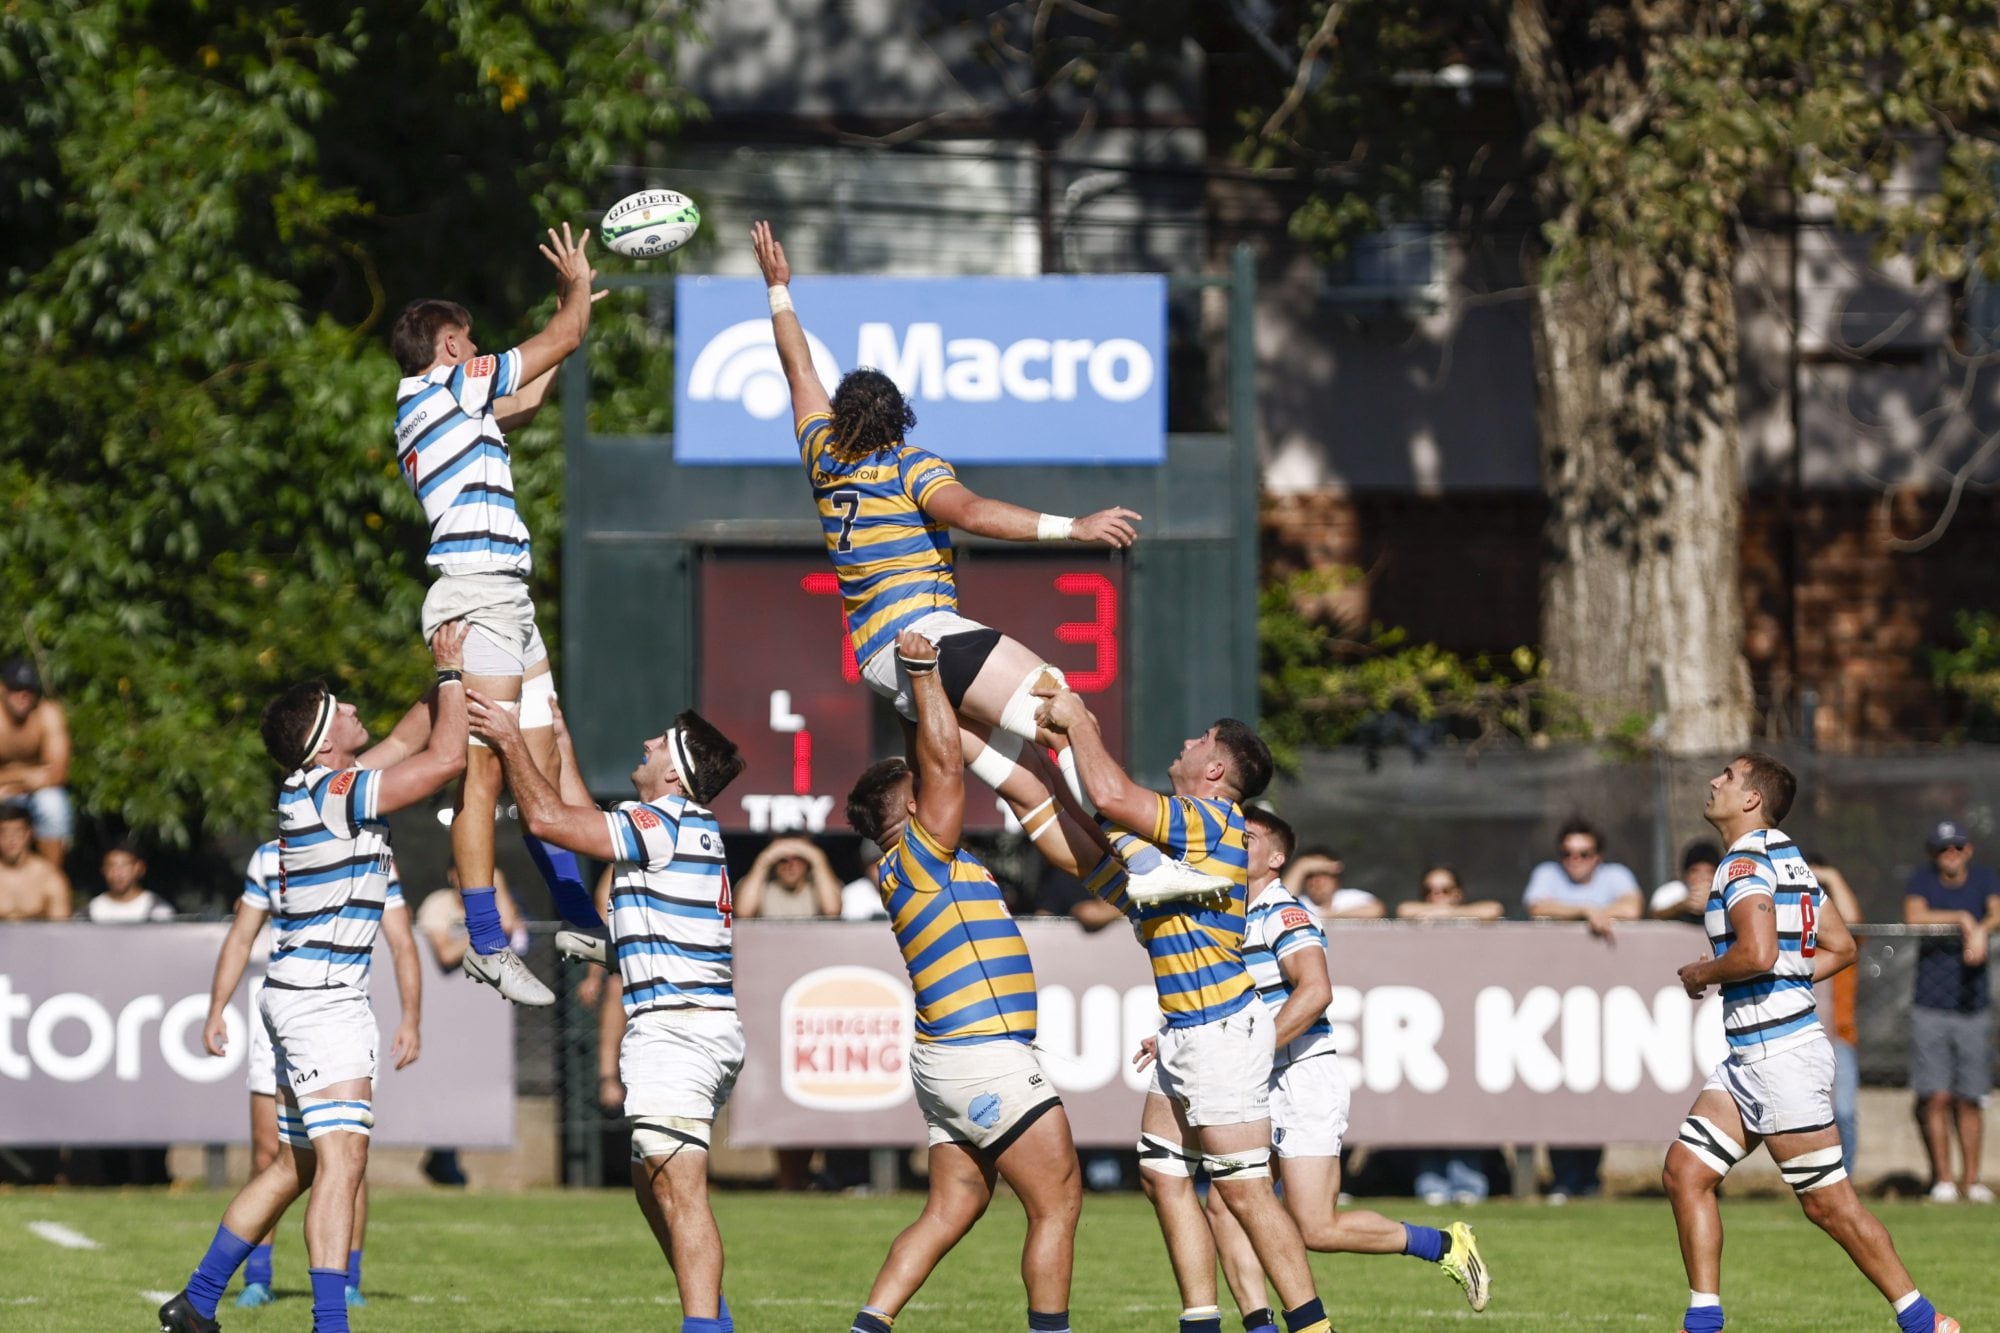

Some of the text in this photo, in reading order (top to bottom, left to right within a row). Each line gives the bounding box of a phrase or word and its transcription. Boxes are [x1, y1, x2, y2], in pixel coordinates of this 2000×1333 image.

[608, 193, 684, 222] GILBERT
[631, 239, 678, 257] Macro
[857, 321, 1155, 402] Macro
[831, 490, 860, 554] 7
[1054, 572, 1118, 692] 3
[769, 689, 806, 732] L
[741, 795, 835, 833] TRY
[715, 865, 733, 928] 4
[1800, 892, 1816, 958] 8
[794, 1018, 903, 1036] BURGER
[794, 1044, 903, 1073] KING
